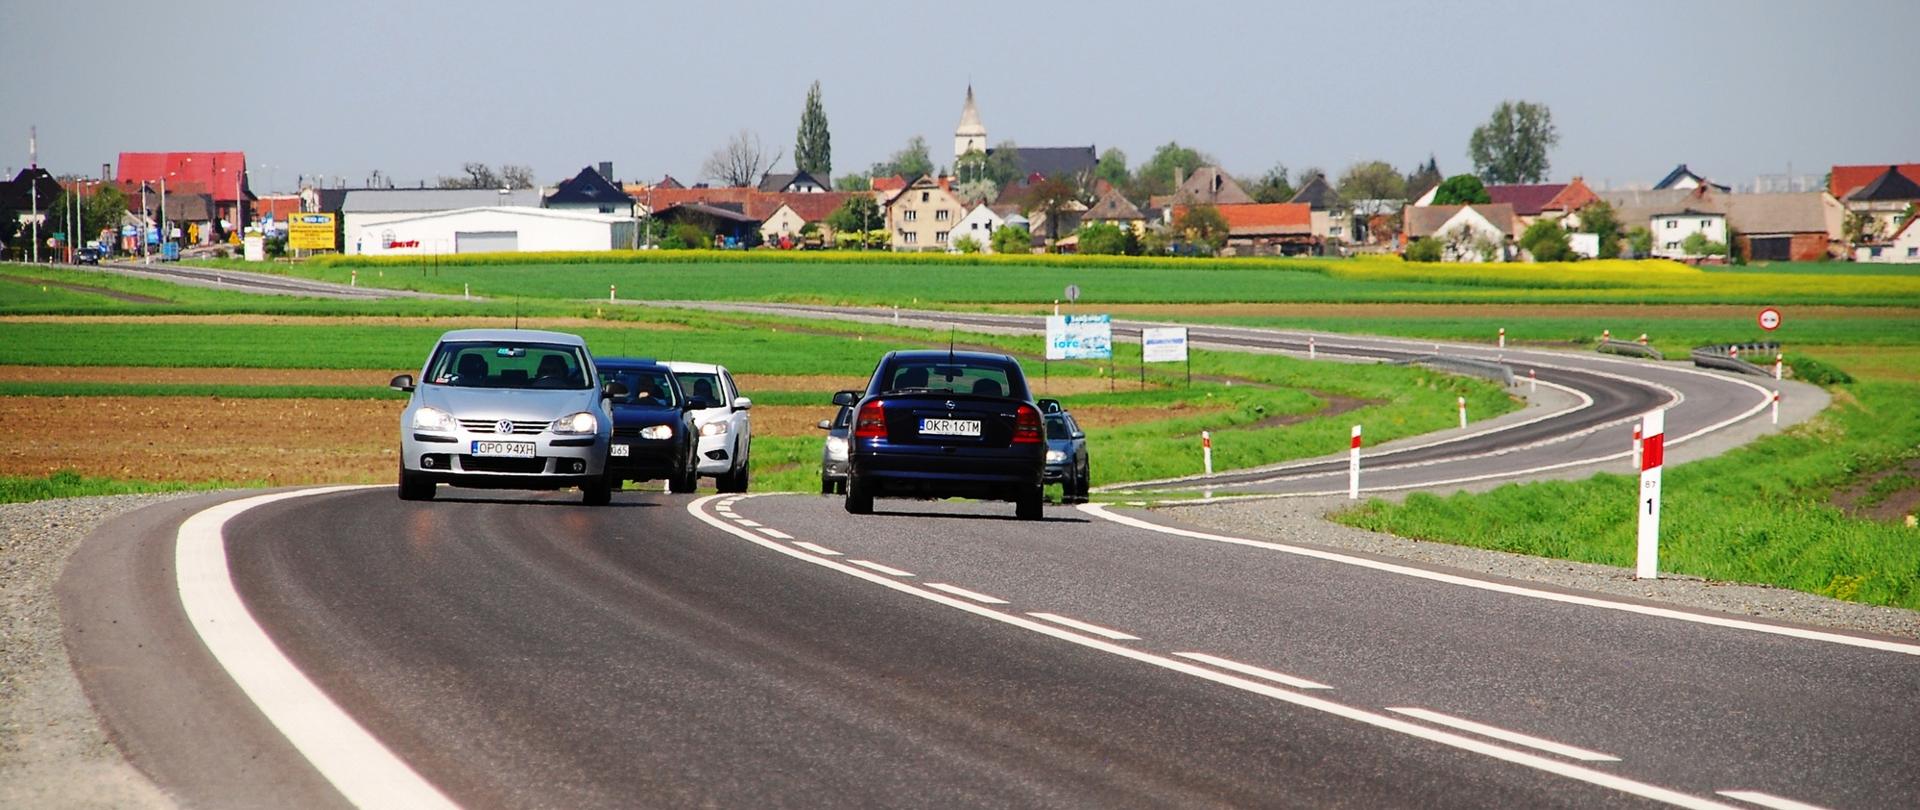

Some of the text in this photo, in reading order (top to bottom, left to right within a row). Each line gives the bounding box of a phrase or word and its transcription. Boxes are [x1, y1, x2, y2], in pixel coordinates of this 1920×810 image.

[954, 421, 980, 432] 16TM
[506, 443, 533, 454] 94XH
[1646, 498, 1653, 515] 1
